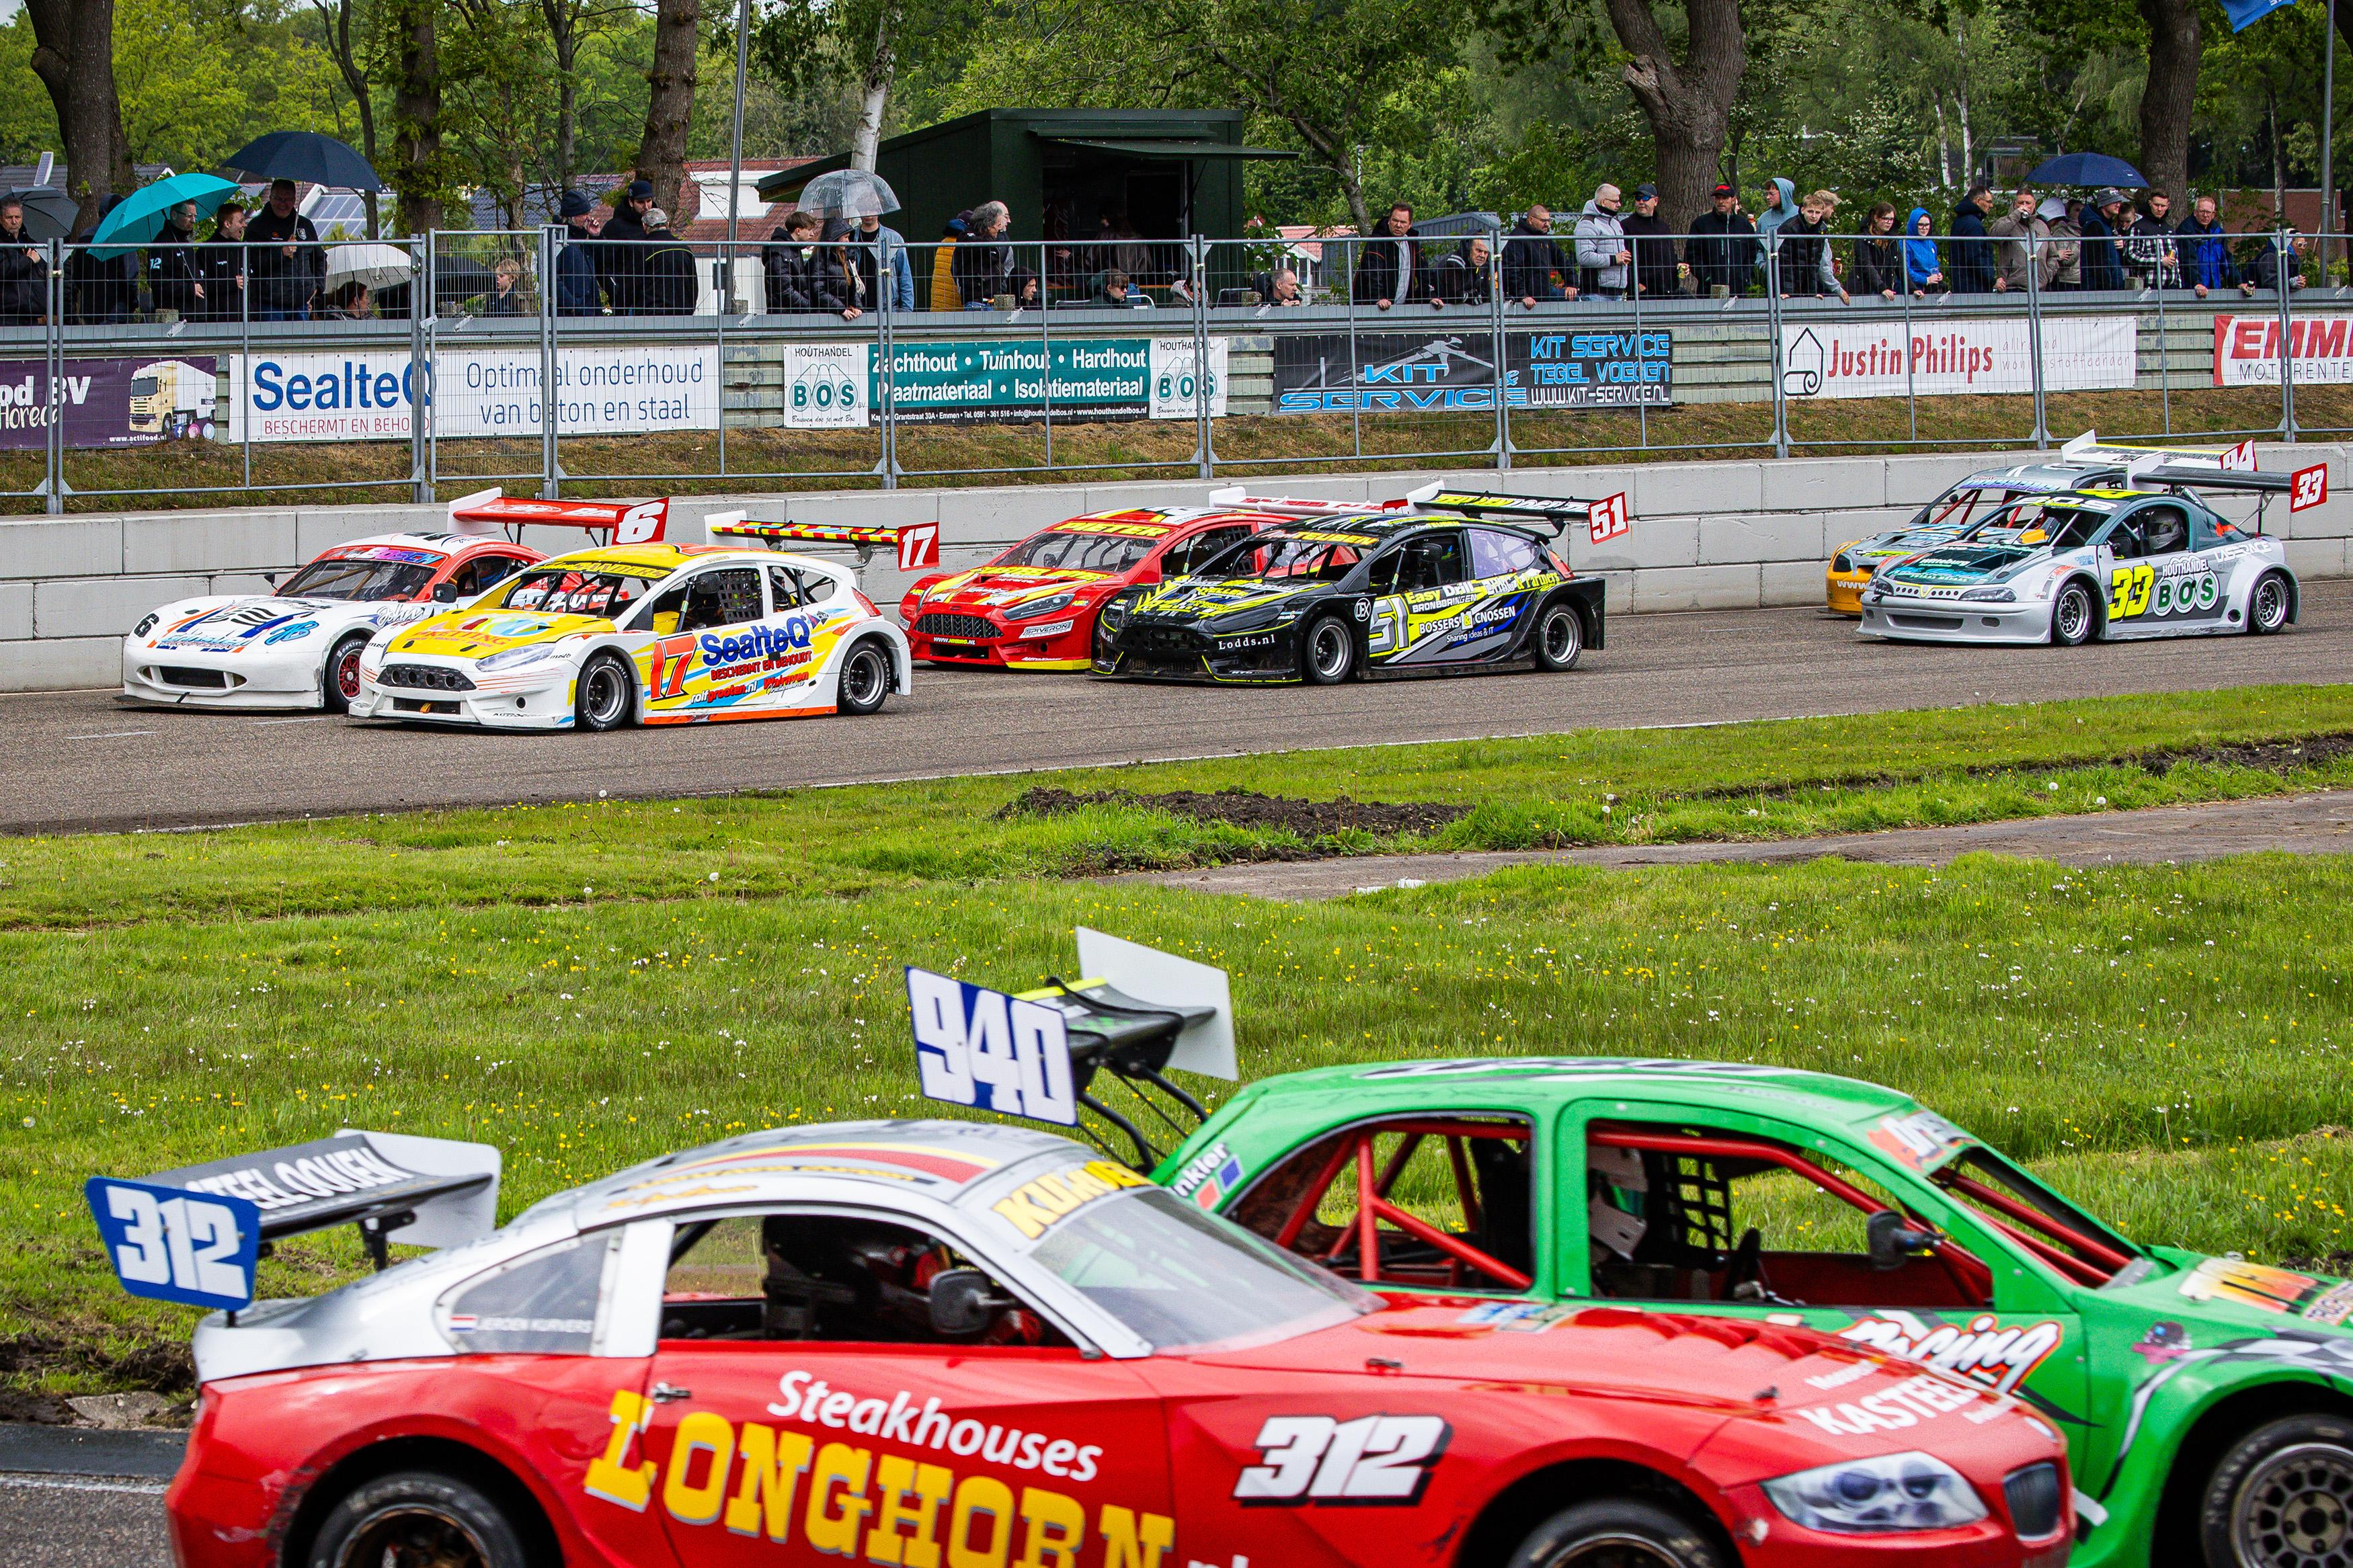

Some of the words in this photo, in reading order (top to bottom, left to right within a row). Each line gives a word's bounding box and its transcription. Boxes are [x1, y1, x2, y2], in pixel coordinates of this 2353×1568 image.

[795, 347, 852, 357] HOUTHANDEL
[1160, 341, 1213, 350] HOUTHADL
[1530, 336, 1564, 358] KIT
[1571, 334, 1669, 358] SERVICE
[2003, 337, 2057, 352] allrnd
[2231, 321, 2353, 359] EMM
[980, 349, 1051, 370] Tuinhout
[1072, 348, 1146, 368] Hardhout
[1828, 338, 1902, 377] Justin
[1911, 334, 1993, 384] Philips
[580, 358, 703, 386] onderhoud
[1364, 364, 1448, 383] KIT
[1530, 363, 1589, 384] TEGEL
[253, 360, 437, 411] SealteQ
[794, 384, 854, 407] BOS
[877, 378, 992, 402] Paatmateriaal
[1015, 376, 1143, 399] Isolatiemateriaal
[1158, 376, 1214, 398] BOS
[481, 403, 520, 424] van
[604, 401, 630, 421] en
[638, 394, 690, 420] staal
[1014, 408, 1073, 418] info@houthadelbos.nl
[1077, 407, 1147, 415] www.houthandelbos.nl
[1279, 388, 1527, 412] SERVICE
[265, 419, 345, 434] BESCHERMT
[352, 419, 368, 432] EN
[374, 417, 437, 431] BEHOD
[2223, 440, 2254, 470] 94
[2293, 468, 2324, 509] 33
[616, 502, 664, 544] 6
[1053, 522, 1170, 537] PIETER
[1591, 497, 1626, 540] 51
[900, 525, 936, 570] 17
[1292, 531, 1380, 546] TEUBEN
[1525, 571, 1560, 589] Partners
[2162, 559, 2210, 577] HOUTHANDEL
[1406, 589, 1441, 605] Easy
[1443, 581, 1474, 596] Drill
[1412, 593, 1477, 614] BRONBORINGEN
[2108, 565, 2155, 620] 33
[2158, 577, 2214, 608] BOS
[1025, 622, 1068, 634] SPIVERON
[1419, 618, 1460, 634] BOSSERS
[1476, 606, 1516, 624] CNOSSEN
[701, 616, 812, 667] SealteQ
[1218, 633, 1276, 650] Lodds.nl
[1446, 633, 1468, 644] Sharing
[1468, 630, 1483, 641] ideas
[1489, 626, 1494, 635] IT
[650, 632, 698, 701] 17
[711, 661, 761, 681] BESCHERMT
[762, 658, 774, 671] EN
[776, 650, 813, 669] BEHOUDT
[690, 680, 758, 704] rolfgrooten.nl
[908, 968, 1076, 1126] 940
[105, 1185, 248, 1299] 312
[766, 1369, 1103, 1482] Steakhouses
[1232, 1414, 1452, 1507] 312
[583, 1388, 1175, 1568] LONGHORN
